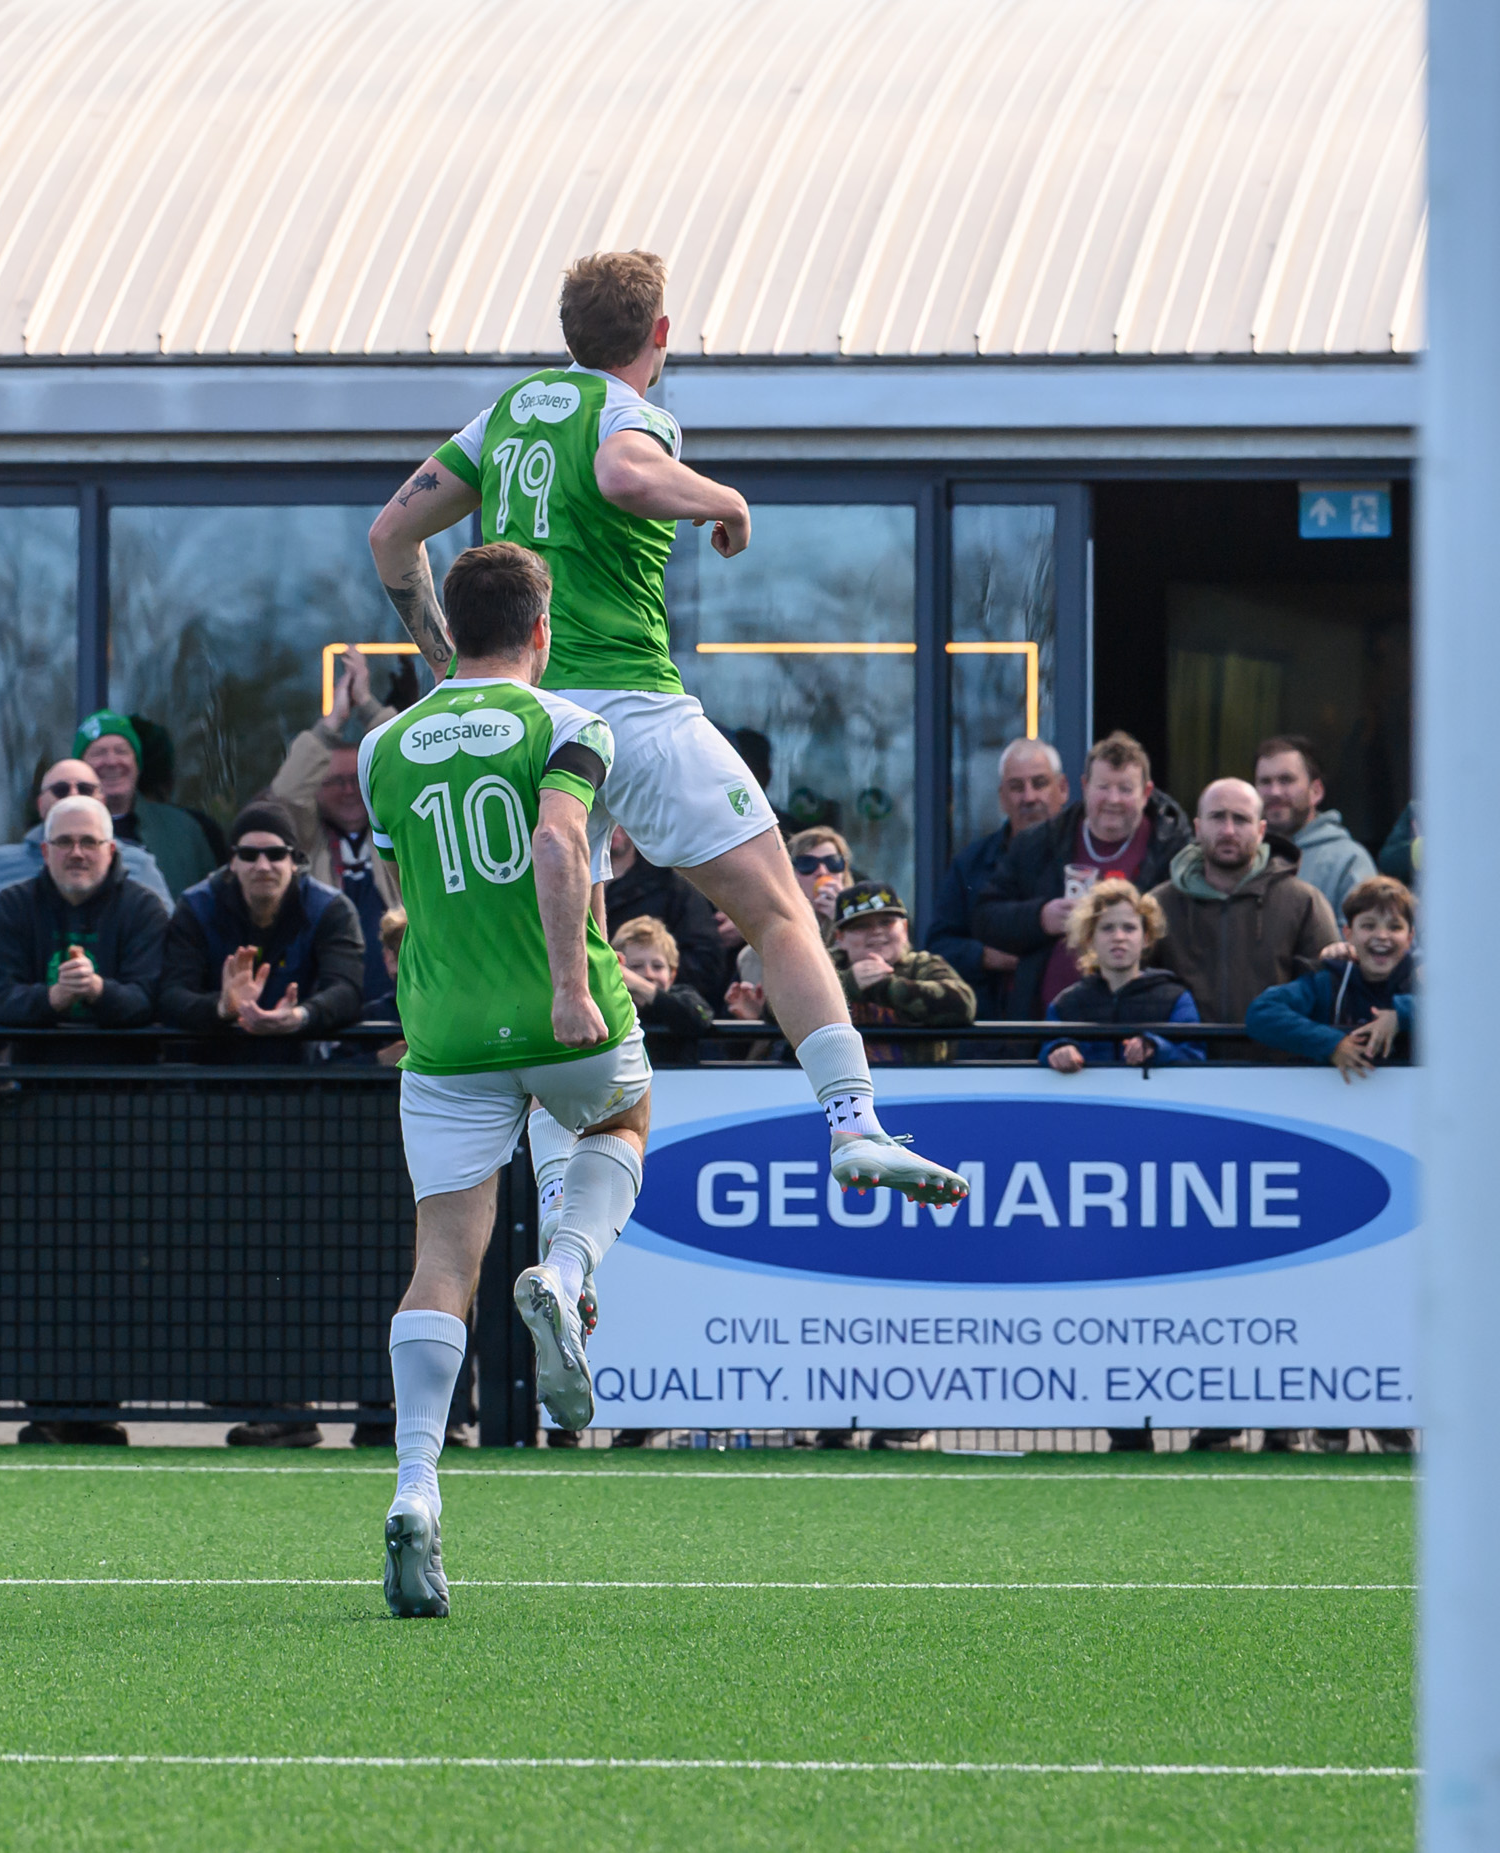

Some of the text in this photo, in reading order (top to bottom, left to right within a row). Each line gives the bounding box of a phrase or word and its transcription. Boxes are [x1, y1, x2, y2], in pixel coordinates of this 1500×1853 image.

[492, 437, 556, 538] 19
[411, 723, 511, 750] Specsavers
[410, 774, 532, 894] 10
[705, 1317, 1299, 1346] CIVIL ENGINEERING CONTRACTOR
[594, 1366, 1414, 1402] QUALITY. INNOVATION. EXCELLENCE.
